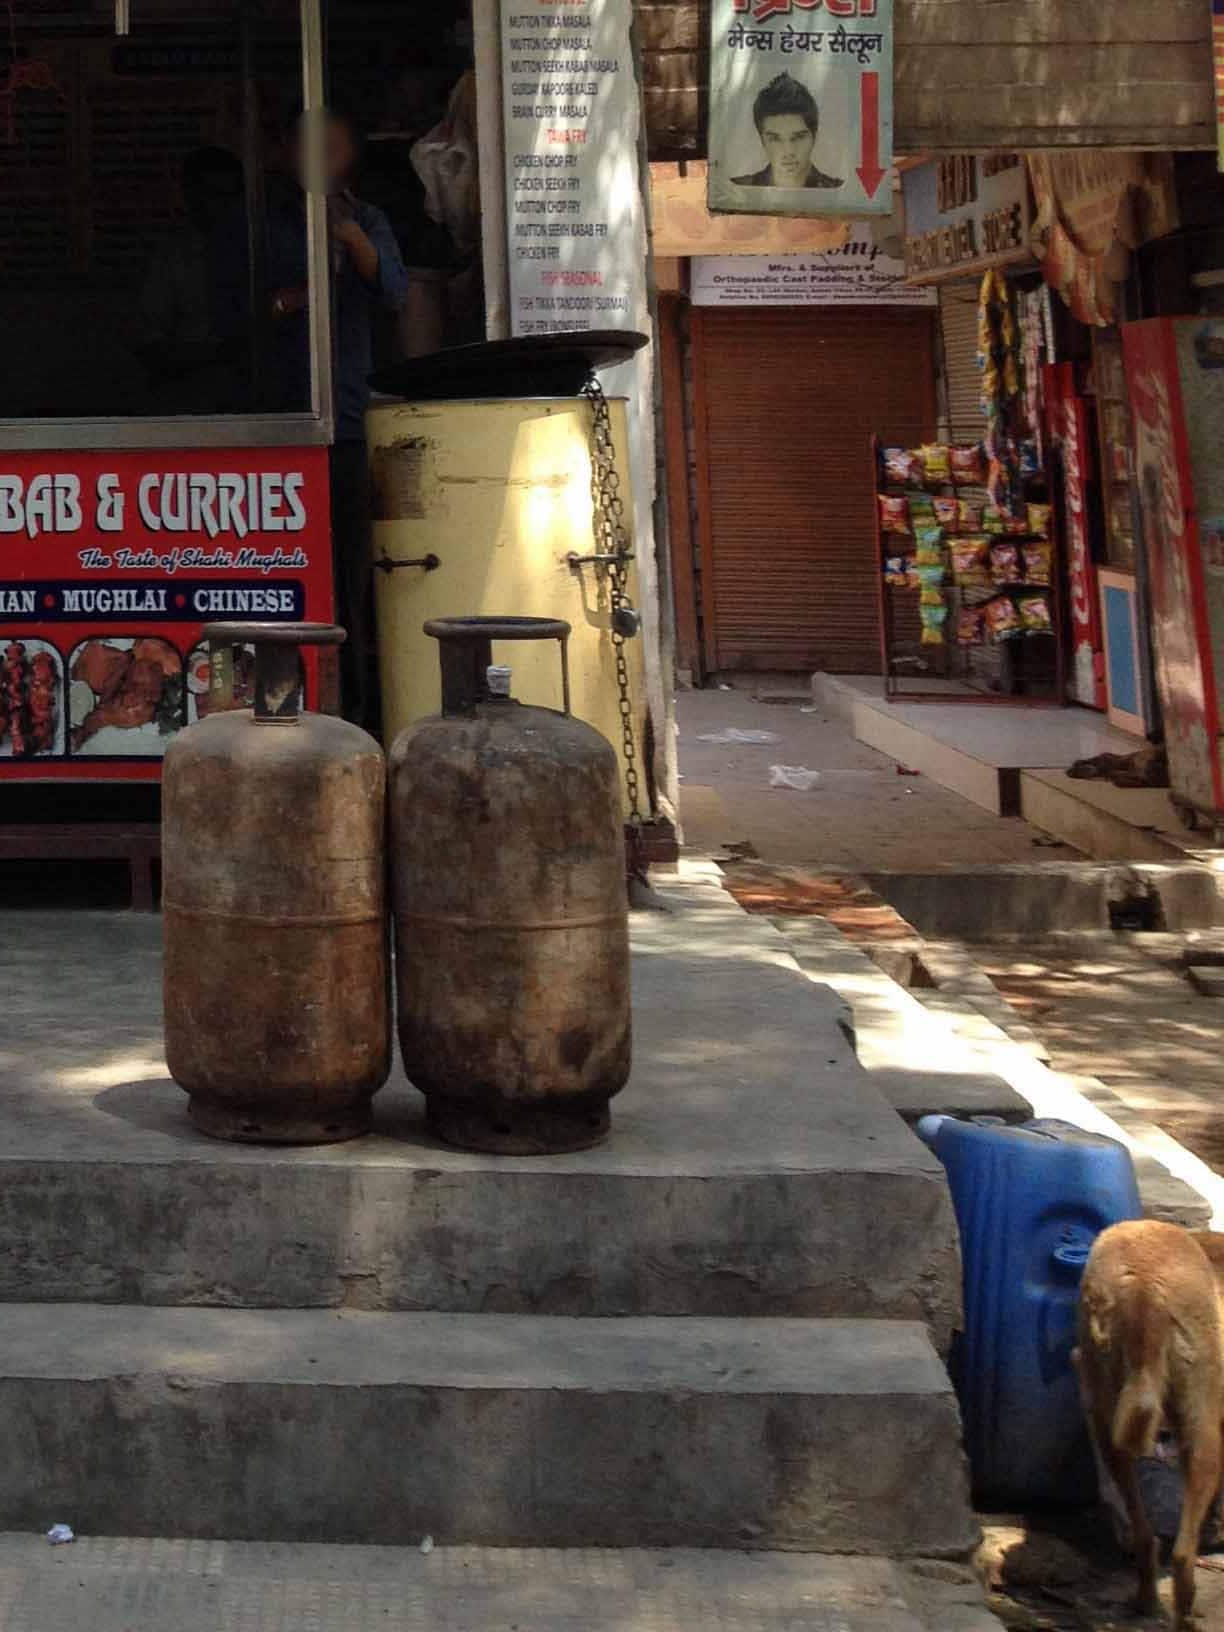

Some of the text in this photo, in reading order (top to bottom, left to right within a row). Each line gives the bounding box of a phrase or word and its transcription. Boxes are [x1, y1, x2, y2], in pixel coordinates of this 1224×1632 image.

[727, 23, 883, 65] मेन्स हेयर सैलून
[96, 473, 125, 531] &
[137, 472, 307, 538] CURRIES
[78, 547, 309, 574] The Taste of Shahi Mughals
[62, 589, 167, 612] MUGHLAI
[194, 588, 295, 612] CHINESE
